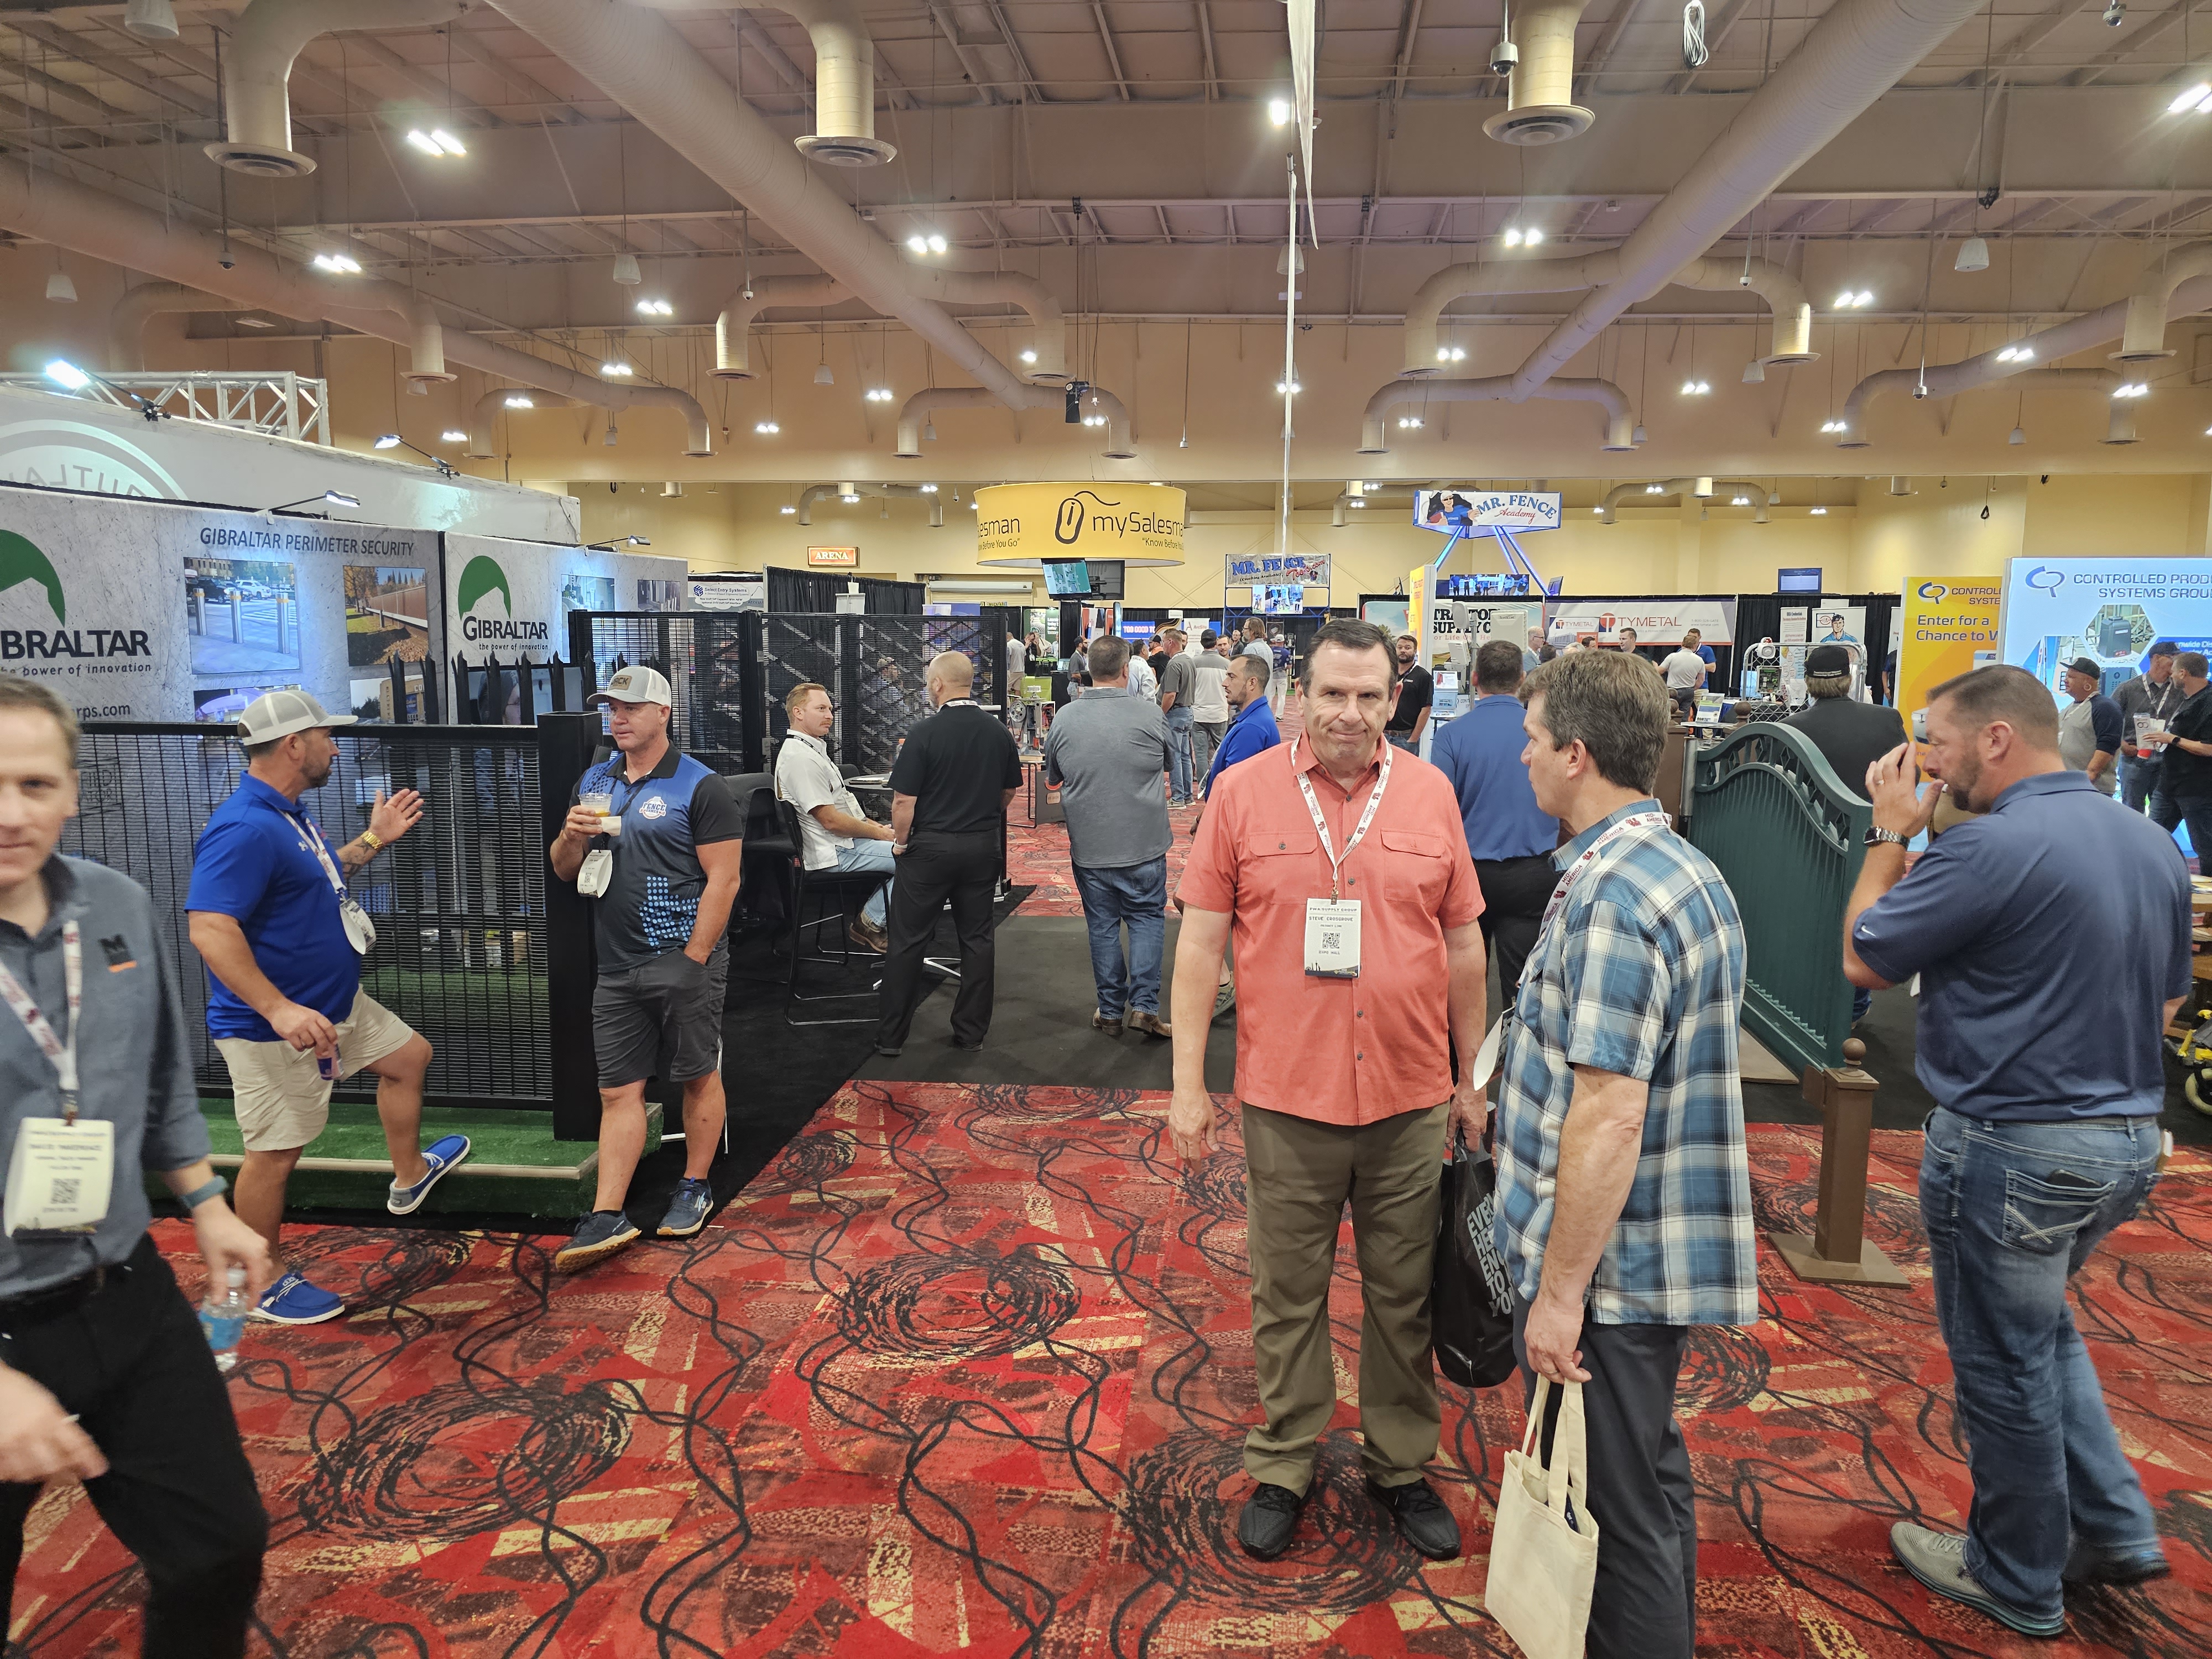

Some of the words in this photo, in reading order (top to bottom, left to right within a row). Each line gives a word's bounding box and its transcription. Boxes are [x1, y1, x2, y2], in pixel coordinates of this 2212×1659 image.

[1477, 497, 1505, 514] MR.
[1509, 495, 1557, 519] FENCE
[1495, 508, 1537, 525] Academy
[200, 526, 281, 550] GIBRALTAR
[285, 534, 358, 554] PERIMETER
[361, 539, 414, 556] SECURITY
[982, 540, 995, 550] Before
[1164, 539, 1178, 549] Before
[815, 551, 849, 560] ARENA
[1231, 561, 1261, 576] MR.
[1261, 556, 1306, 572] FENCE
[2074, 573, 2167, 584] CONTROLLED
[2170, 573, 2212, 584] PROD
[2099, 588, 2166, 598] SYSTEMS
[1434, 608, 1500, 620] TRTO
[1918, 615, 1955, 625] Enter
[1959, 615, 1978, 625] for
[463, 615, 549, 641] GIBRALTAR
[1433, 622, 1482, 634] SUP
[1618, 617, 1682, 627] TYMETAL
[1916, 630, 1967, 641] Chance
[1970, 631, 1985, 641] to
[23, 666, 63, 676] power
[68, 664, 81, 676] of
[86, 663, 152, 674] innovation
[73, 704, 131, 718] rps.com
[643, 803, 666, 811] FENCE
[1310, 796, 1320, 816] AMERICA
[1363, 805, 1373, 823] AMERICA
[1598, 827, 1625, 846] AMERICA
[1562, 871, 1571, 883] MID-
[1566, 864, 1583, 887] AMERICA
[1472, 1224, 1494, 1260] HE
[1486, 1270, 1505, 1300] TO
